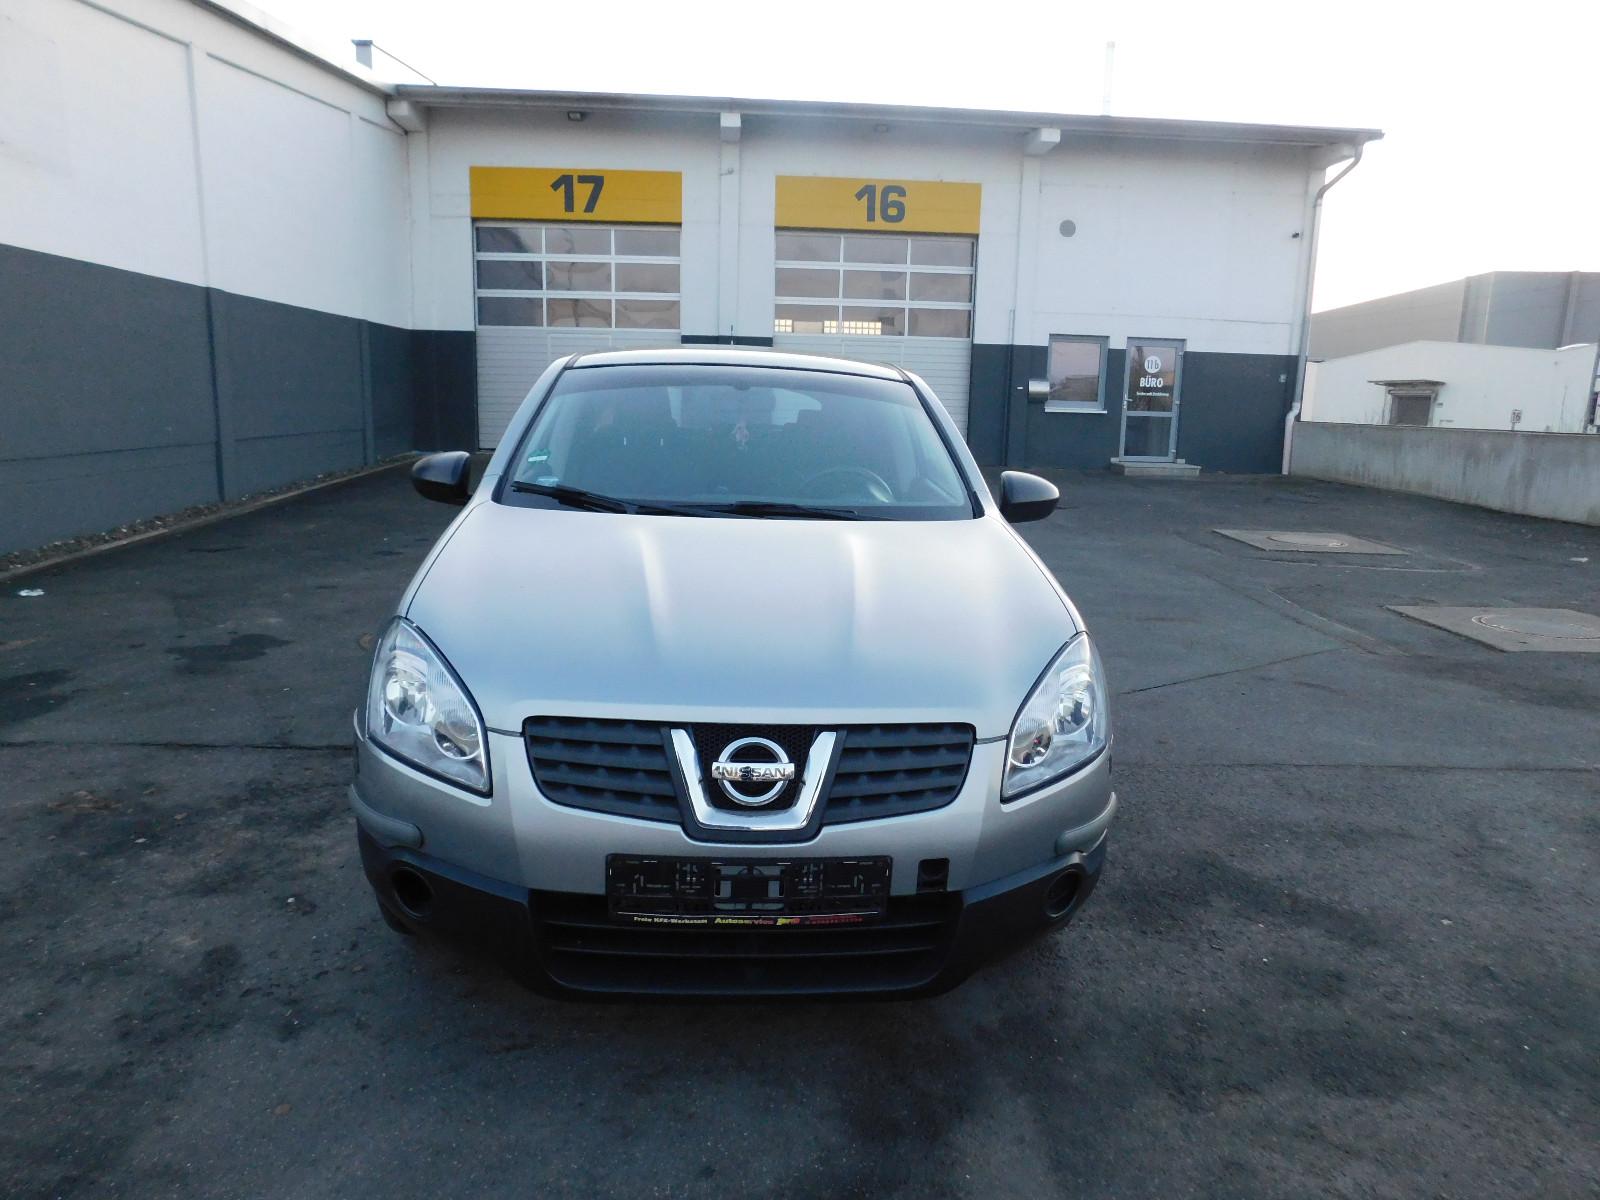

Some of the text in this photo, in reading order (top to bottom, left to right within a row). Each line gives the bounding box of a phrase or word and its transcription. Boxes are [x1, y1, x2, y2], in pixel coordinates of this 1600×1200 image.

[550, 174, 605, 214] 17
[854, 184, 907, 224] 16
[1139, 375, 1164, 387] BÜRO
[721, 766, 786, 778] NISSAN
